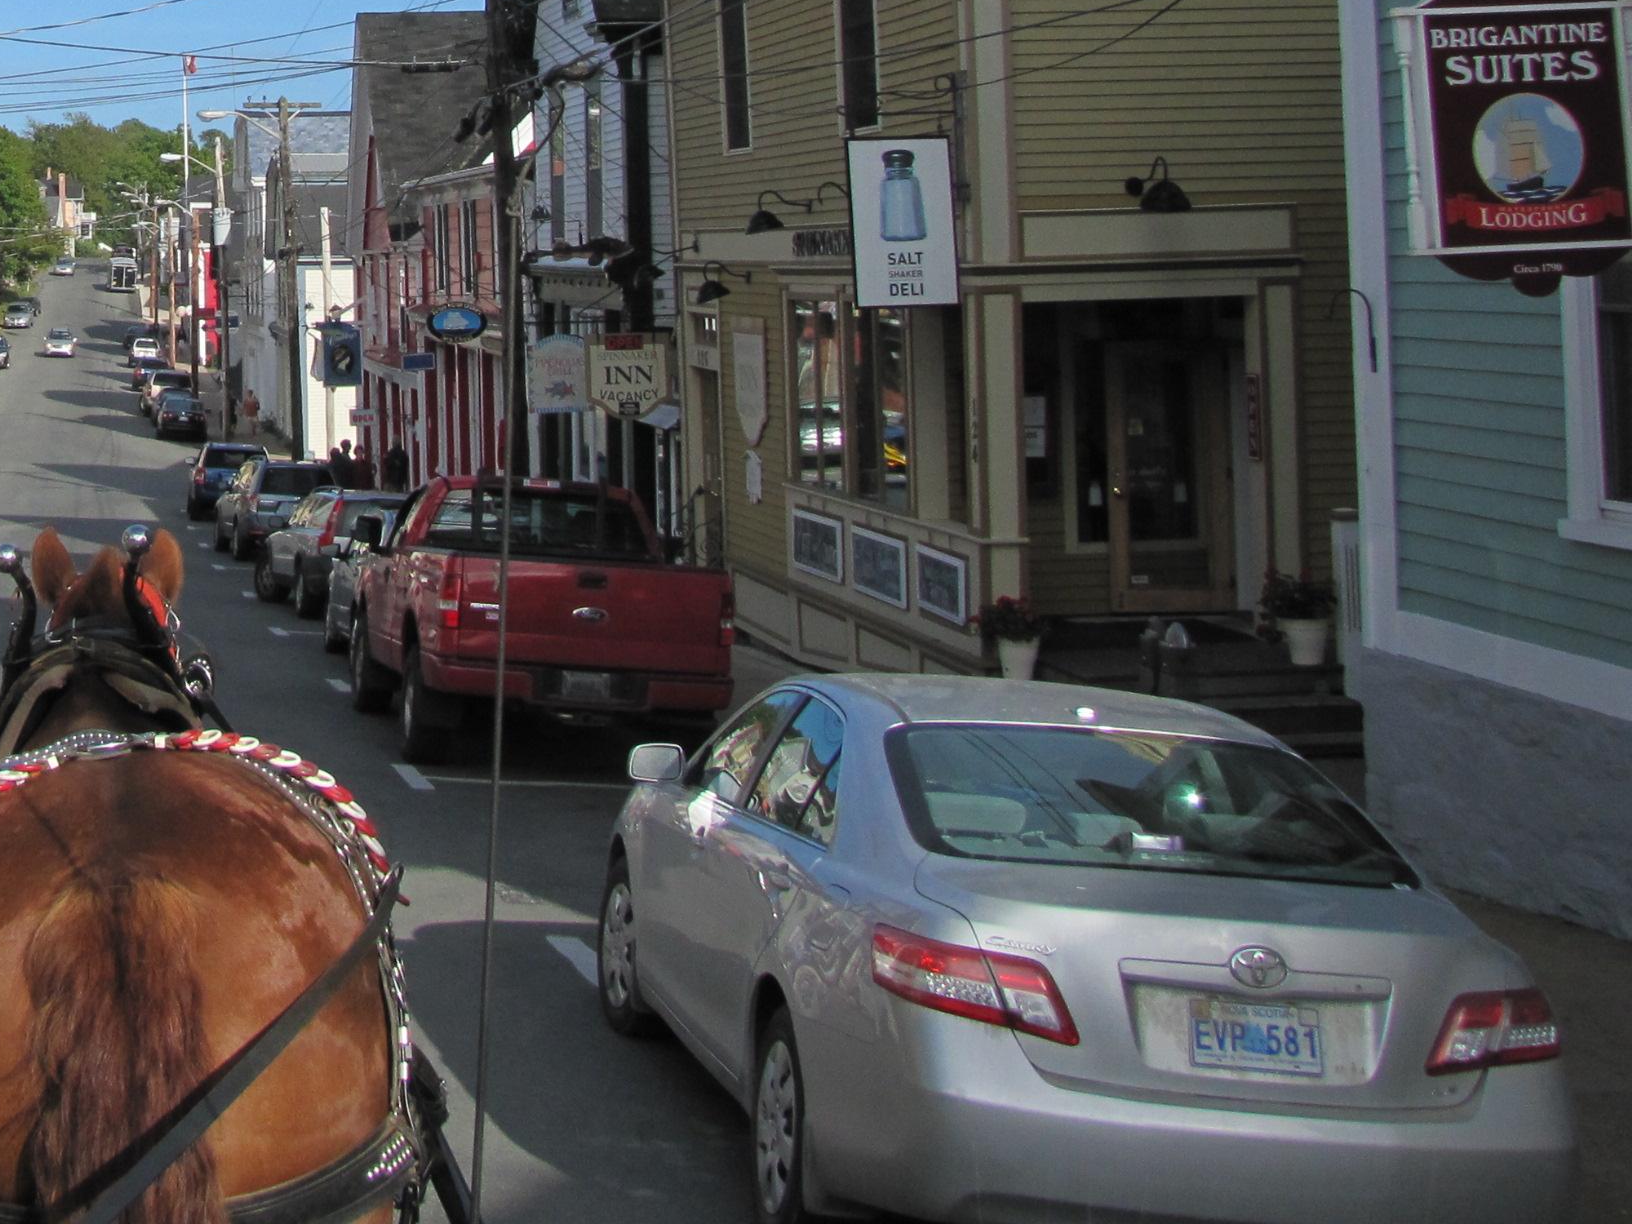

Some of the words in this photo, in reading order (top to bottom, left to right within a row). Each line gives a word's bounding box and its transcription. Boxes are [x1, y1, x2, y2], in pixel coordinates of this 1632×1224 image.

[1429, 22, 1608, 49] BRIGANTINE
[1444, 50, 1600, 86] SUITES
[1479, 203, 1587, 227] LODGING
[887, 252, 924, 265] SALT
[888, 270, 924, 278] SHAKER
[1513, 264, 1539, 274] Circa
[889, 283, 924, 296] DELI
[597, 349, 658, 361] SPINNAKER
[603, 365, 654, 385] INN
[599, 387, 659, 402] VACANCY
[352, 415, 375, 423] OPEN
[1194, 1019, 1246, 1052] EVP
[1266, 1024, 1318, 1058] 581
